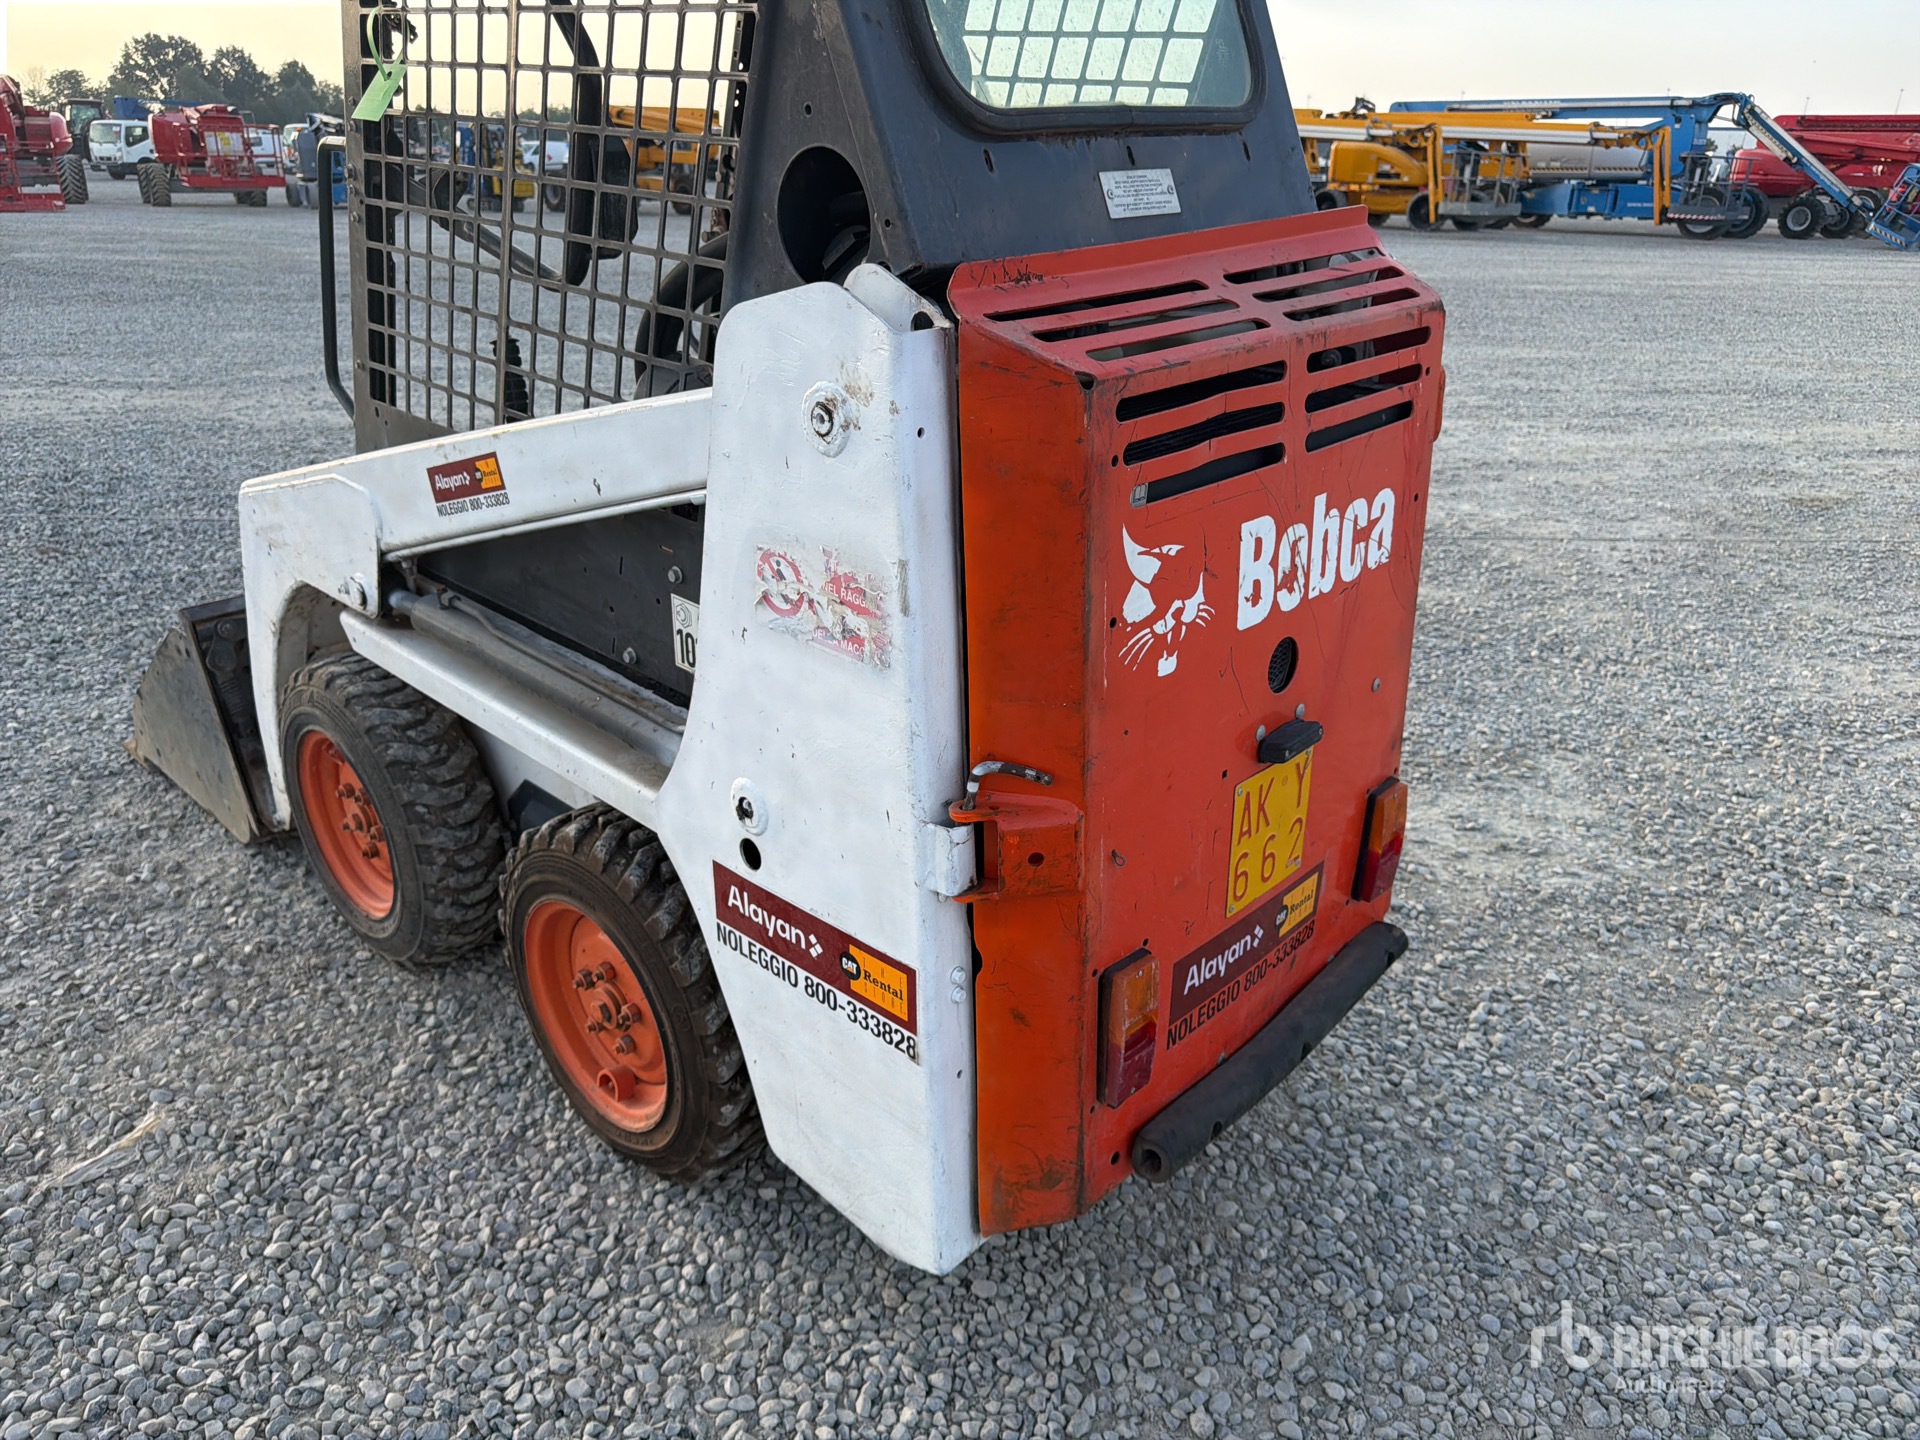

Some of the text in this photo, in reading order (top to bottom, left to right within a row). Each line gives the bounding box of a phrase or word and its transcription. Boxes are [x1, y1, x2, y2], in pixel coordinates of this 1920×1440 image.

[434, 473, 466, 492] Alayan
[436, 492, 510, 517] NOLEGGIO 800-333828
[841, 587, 868, 608] RAGG
[676, 628, 698, 668] 10
[1237, 756, 1310, 846] AK Y
[728, 884, 806, 950] Alayan
[1290, 889, 1314, 915] Rental
[841, 957, 858, 975] CAT
[1183, 934, 1251, 996] Alayan
[716, 921, 917, 1060] NOLEGGIO 800-333828
[862, 969, 904, 1002] Rental
[1166, 919, 1316, 1050] NOLEGGIO 800-333828
